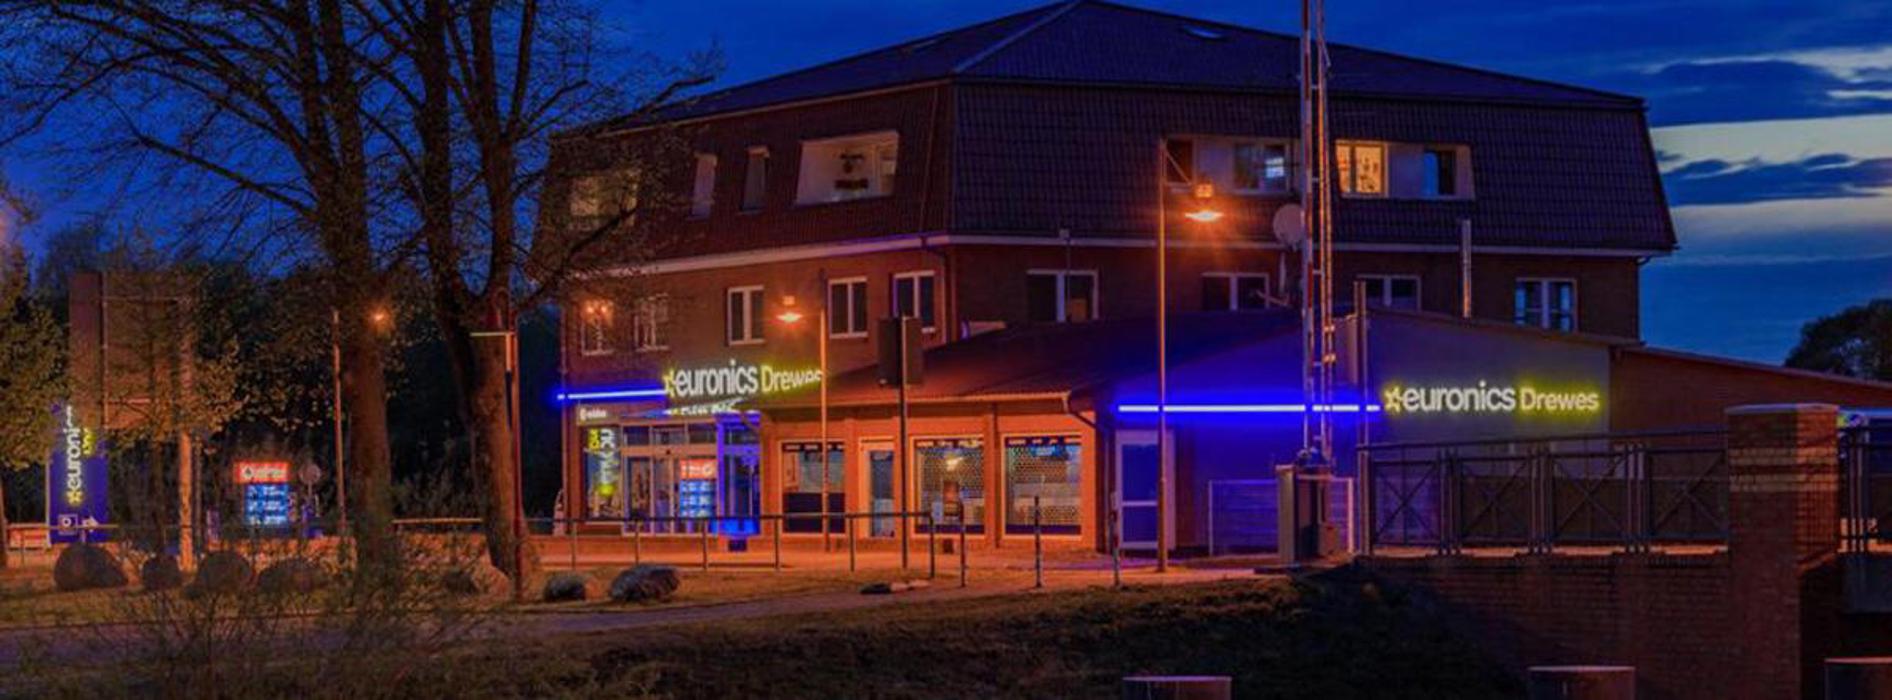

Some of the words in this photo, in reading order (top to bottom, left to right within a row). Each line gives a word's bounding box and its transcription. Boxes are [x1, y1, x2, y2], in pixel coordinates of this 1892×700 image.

[675, 359, 758, 396] euronics
[1402, 381, 1516, 411] euronics
[1520, 388, 1599, 411] Drewes
